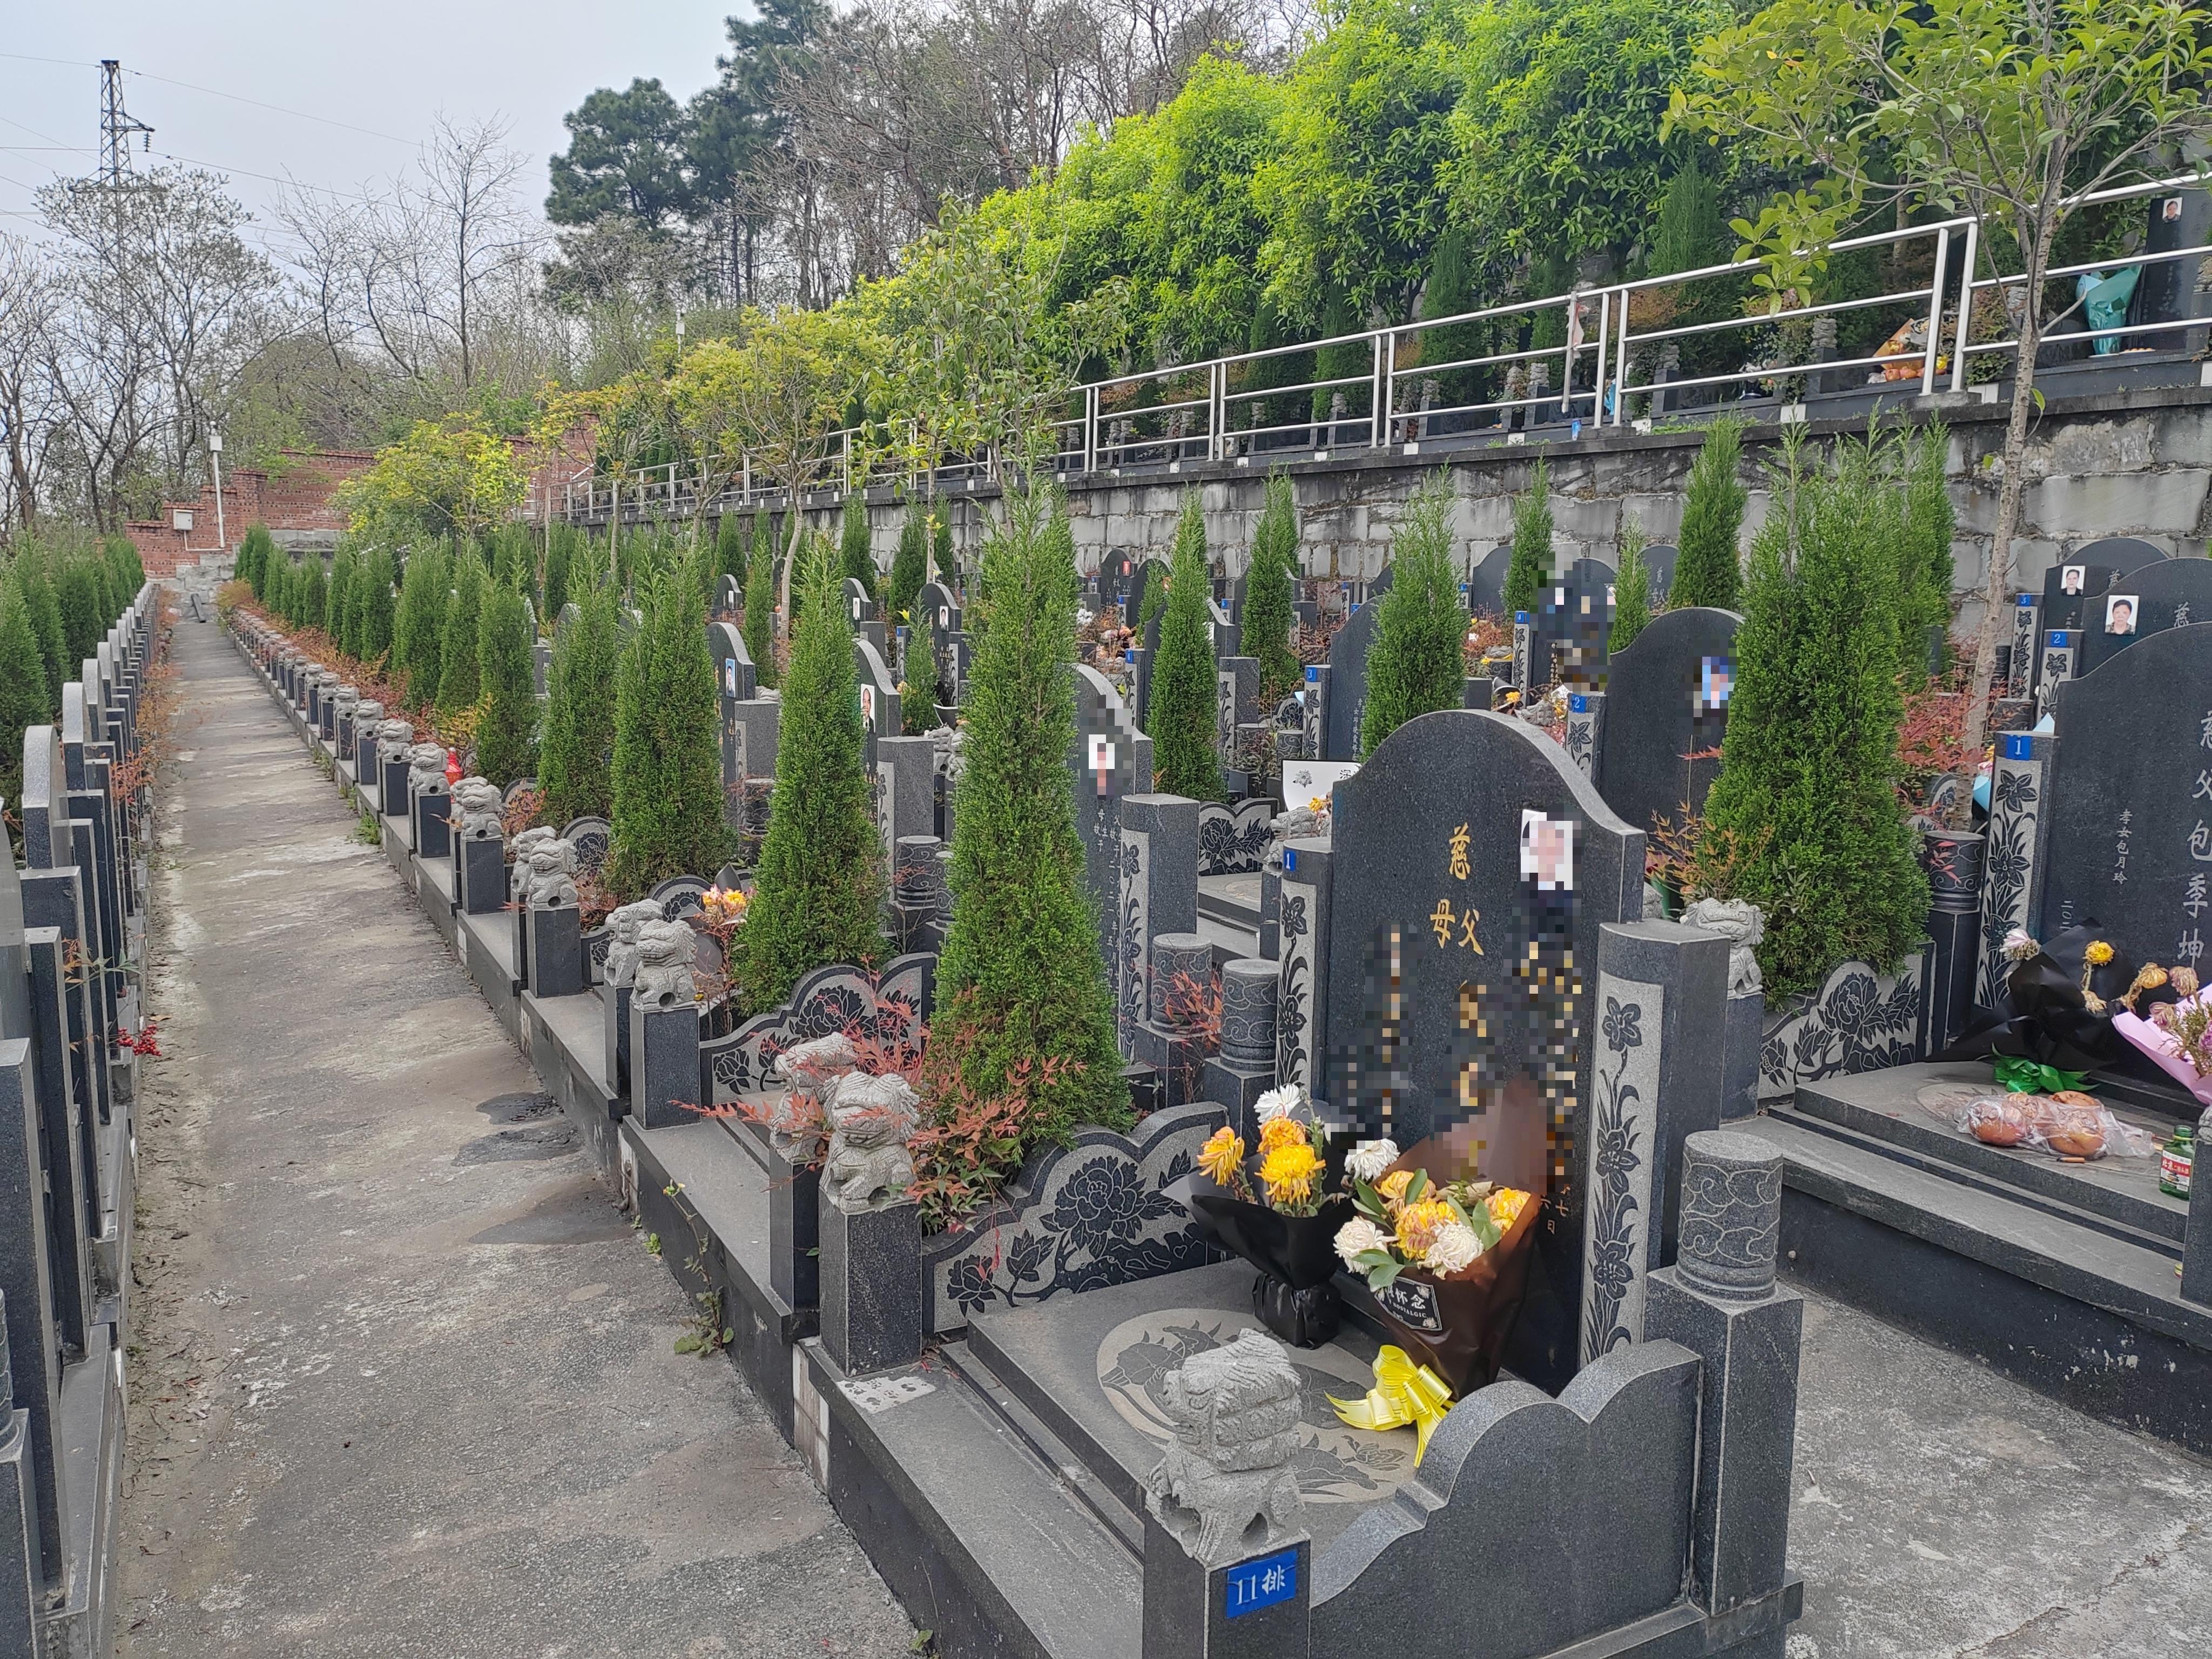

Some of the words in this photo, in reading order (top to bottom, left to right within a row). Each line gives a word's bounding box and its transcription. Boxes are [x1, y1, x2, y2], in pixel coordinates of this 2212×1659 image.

[2174, 602, 2189, 627] 慈
[2054, 634, 2060, 644] 2
[1308, 669, 1313, 679] 3
[1574, 697, 1580, 709] 2
[2015, 739, 2022, 756] 1
[2112, 808, 2133, 885] 孝女包月玲
[1286, 853, 1291, 869] 1
[1392, 1302, 1427, 1318] NOSTALGIC
[1236, 1564, 1286, 1606] 11排
